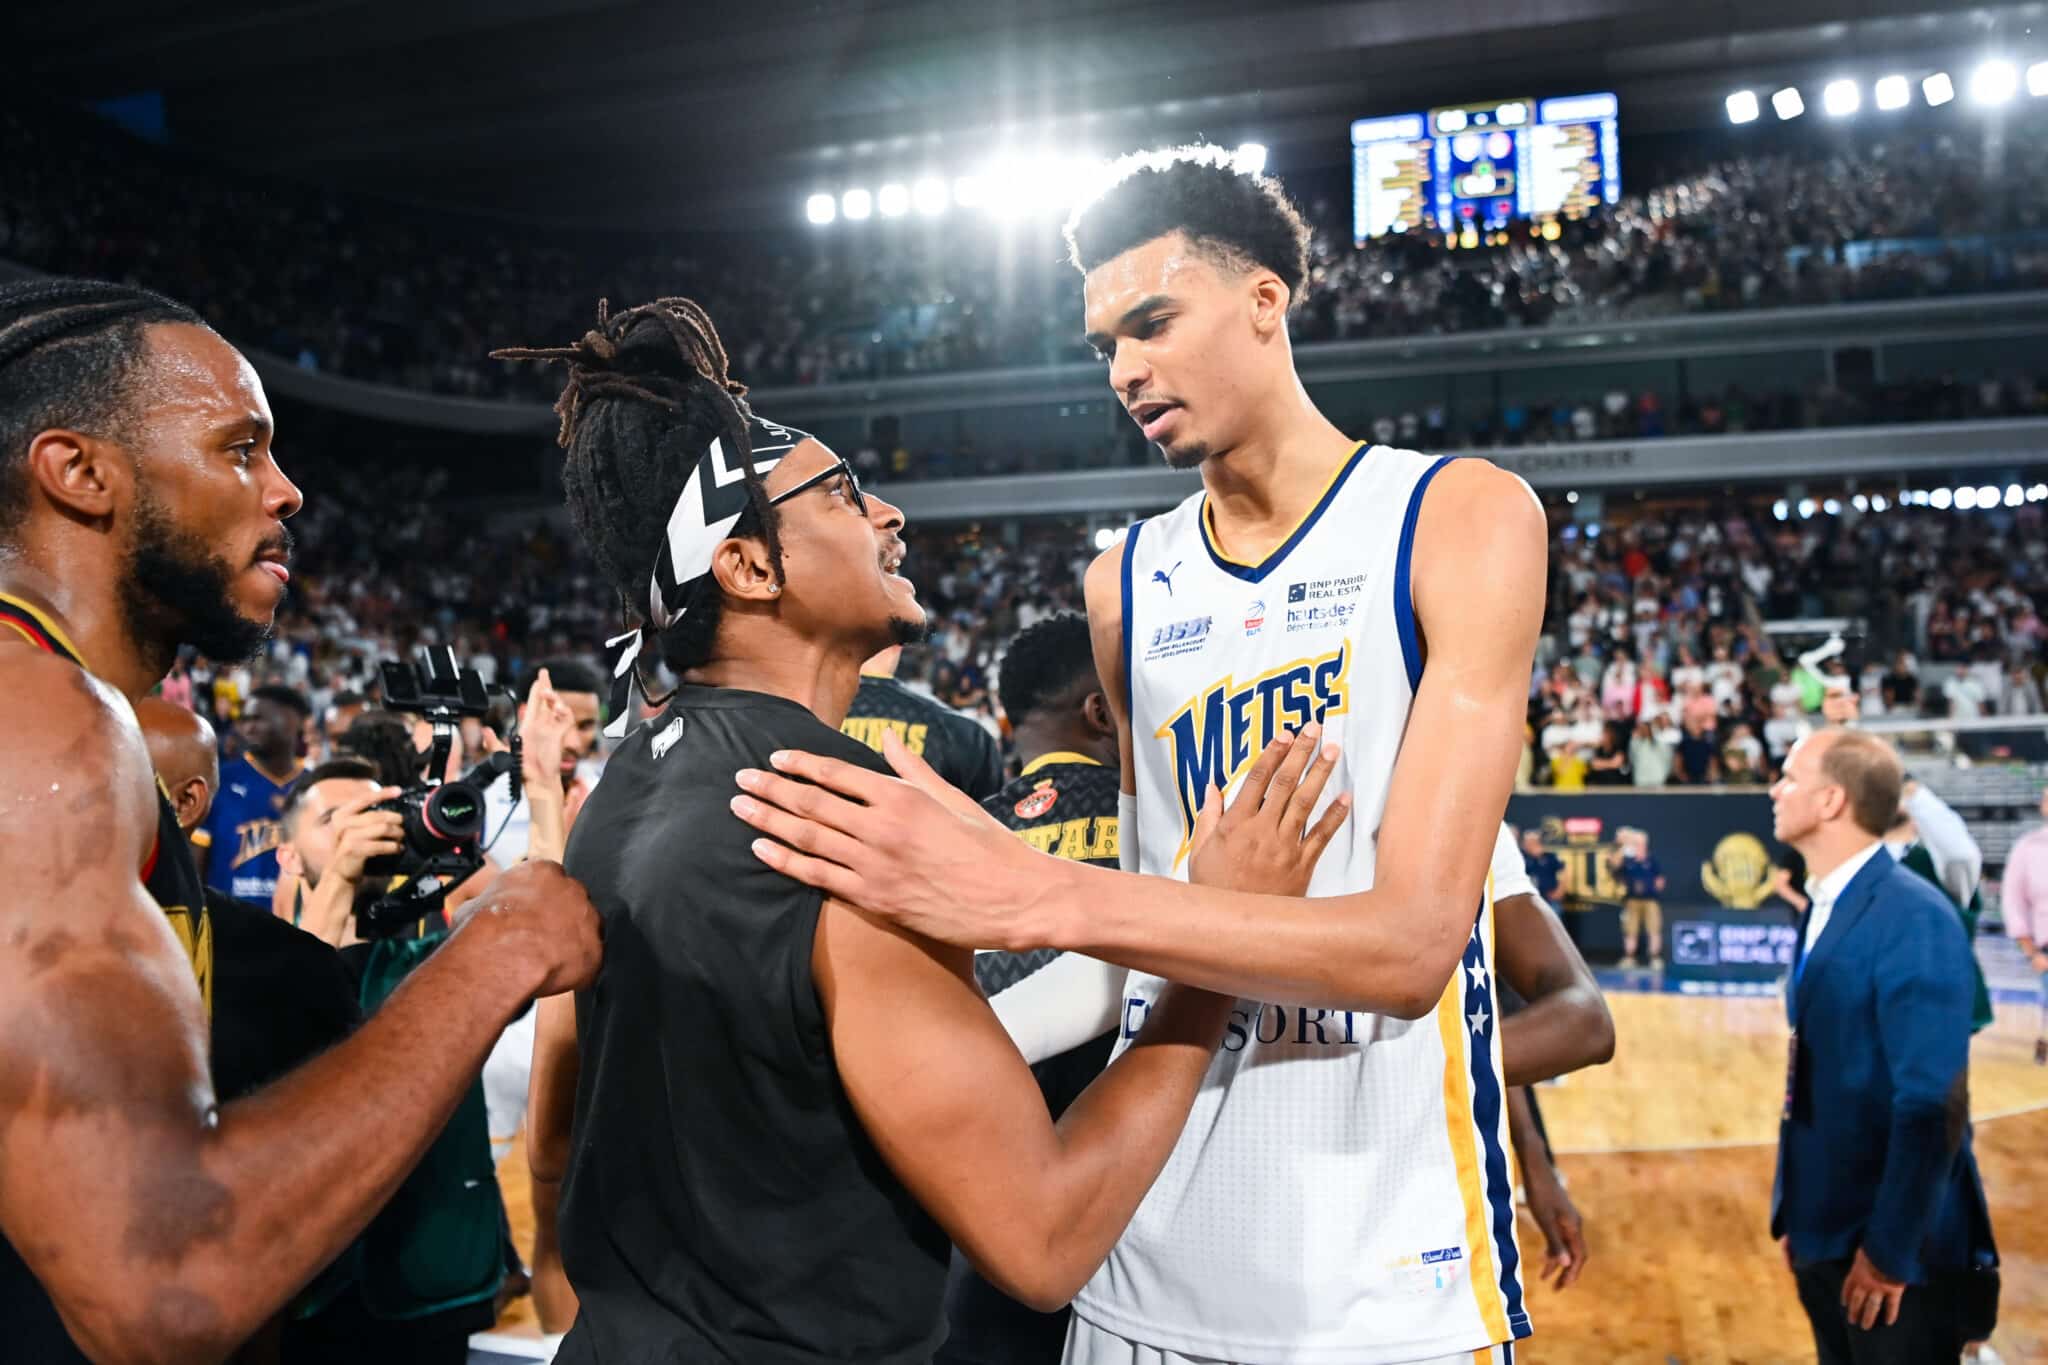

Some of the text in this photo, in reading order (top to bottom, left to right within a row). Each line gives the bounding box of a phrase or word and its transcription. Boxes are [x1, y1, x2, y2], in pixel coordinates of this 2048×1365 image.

[1308, 590, 1335, 599] REAL
[1309, 580, 1332, 589] BNP
[1013, 816, 1120, 861] TAR
[1222, 1002, 1364, 1052] SORT
